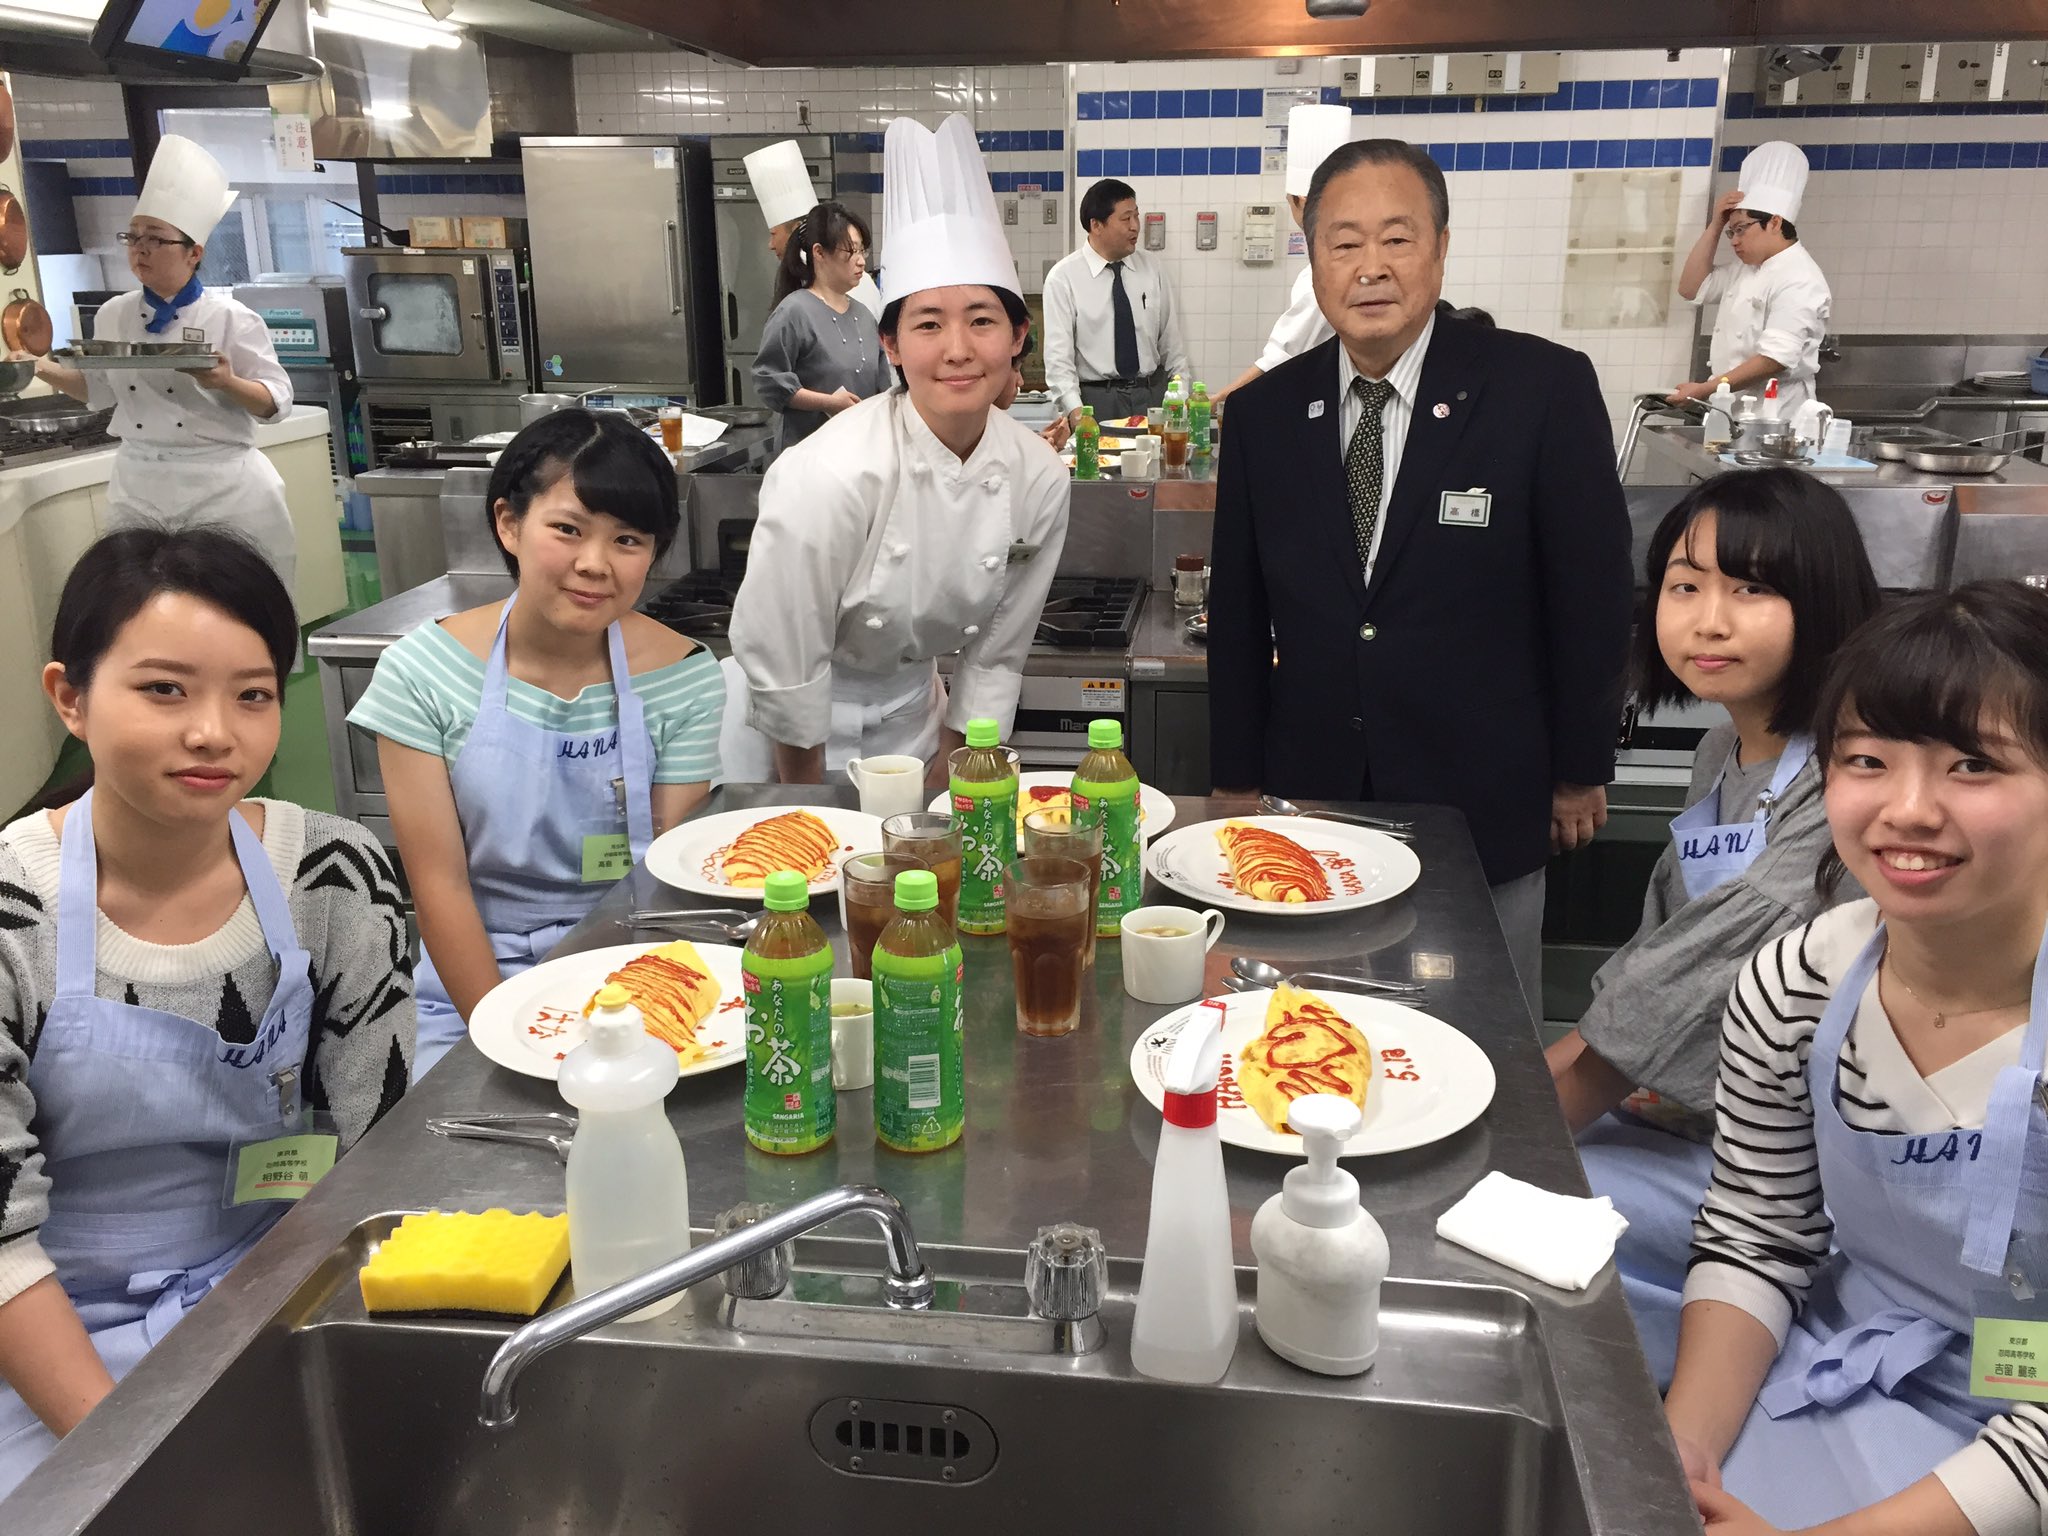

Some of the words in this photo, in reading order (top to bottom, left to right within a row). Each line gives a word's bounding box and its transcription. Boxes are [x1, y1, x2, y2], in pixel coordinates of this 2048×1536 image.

[557, 730, 618, 759] HANA
[983, 797, 993, 841] あなたの
[771, 980, 784, 1035] あなたの
[217, 1009, 287, 1069] HANA
[772, 1113, 804, 1121] SANGARIA
